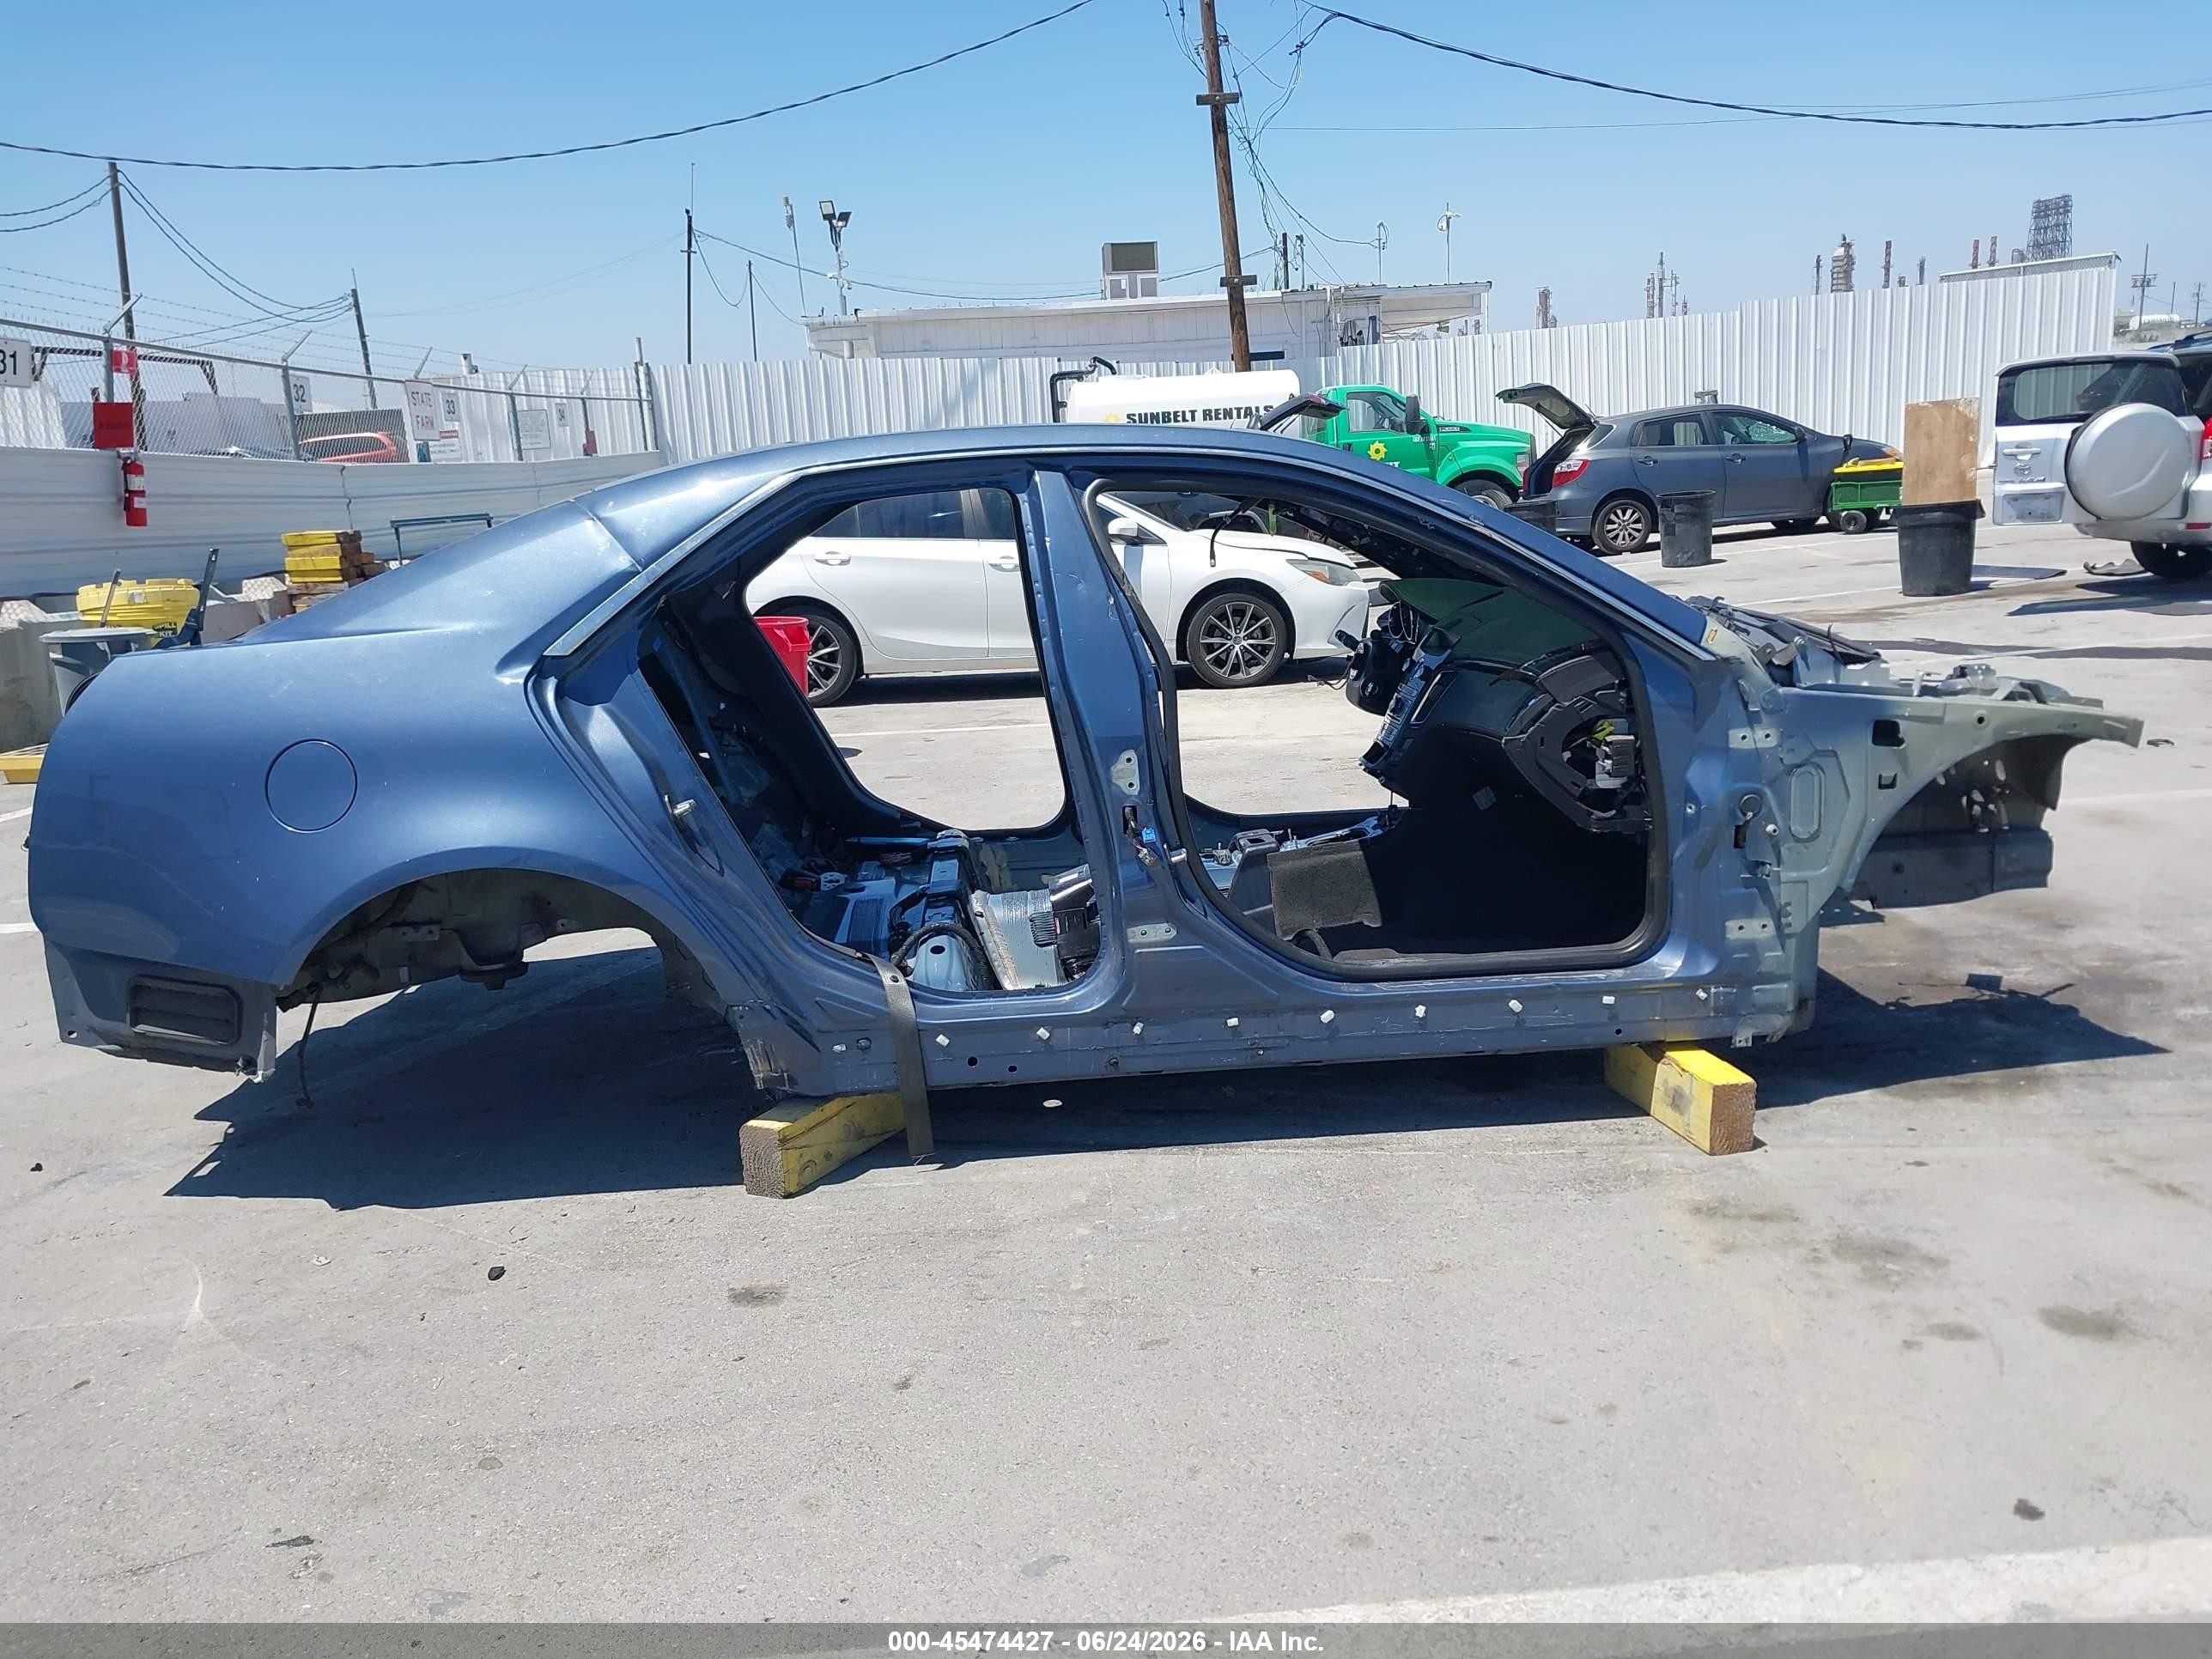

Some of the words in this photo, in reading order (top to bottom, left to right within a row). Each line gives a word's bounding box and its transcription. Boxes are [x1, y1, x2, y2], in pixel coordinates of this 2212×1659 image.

[293, 384, 307, 403] 32
[411, 391, 433, 407] STATE
[446, 399, 455, 415] 33
[1126, 409, 1198, 424] SUNBELT
[1202, 404, 1274, 422] RENTALS
[416, 415, 434, 429] FARM
